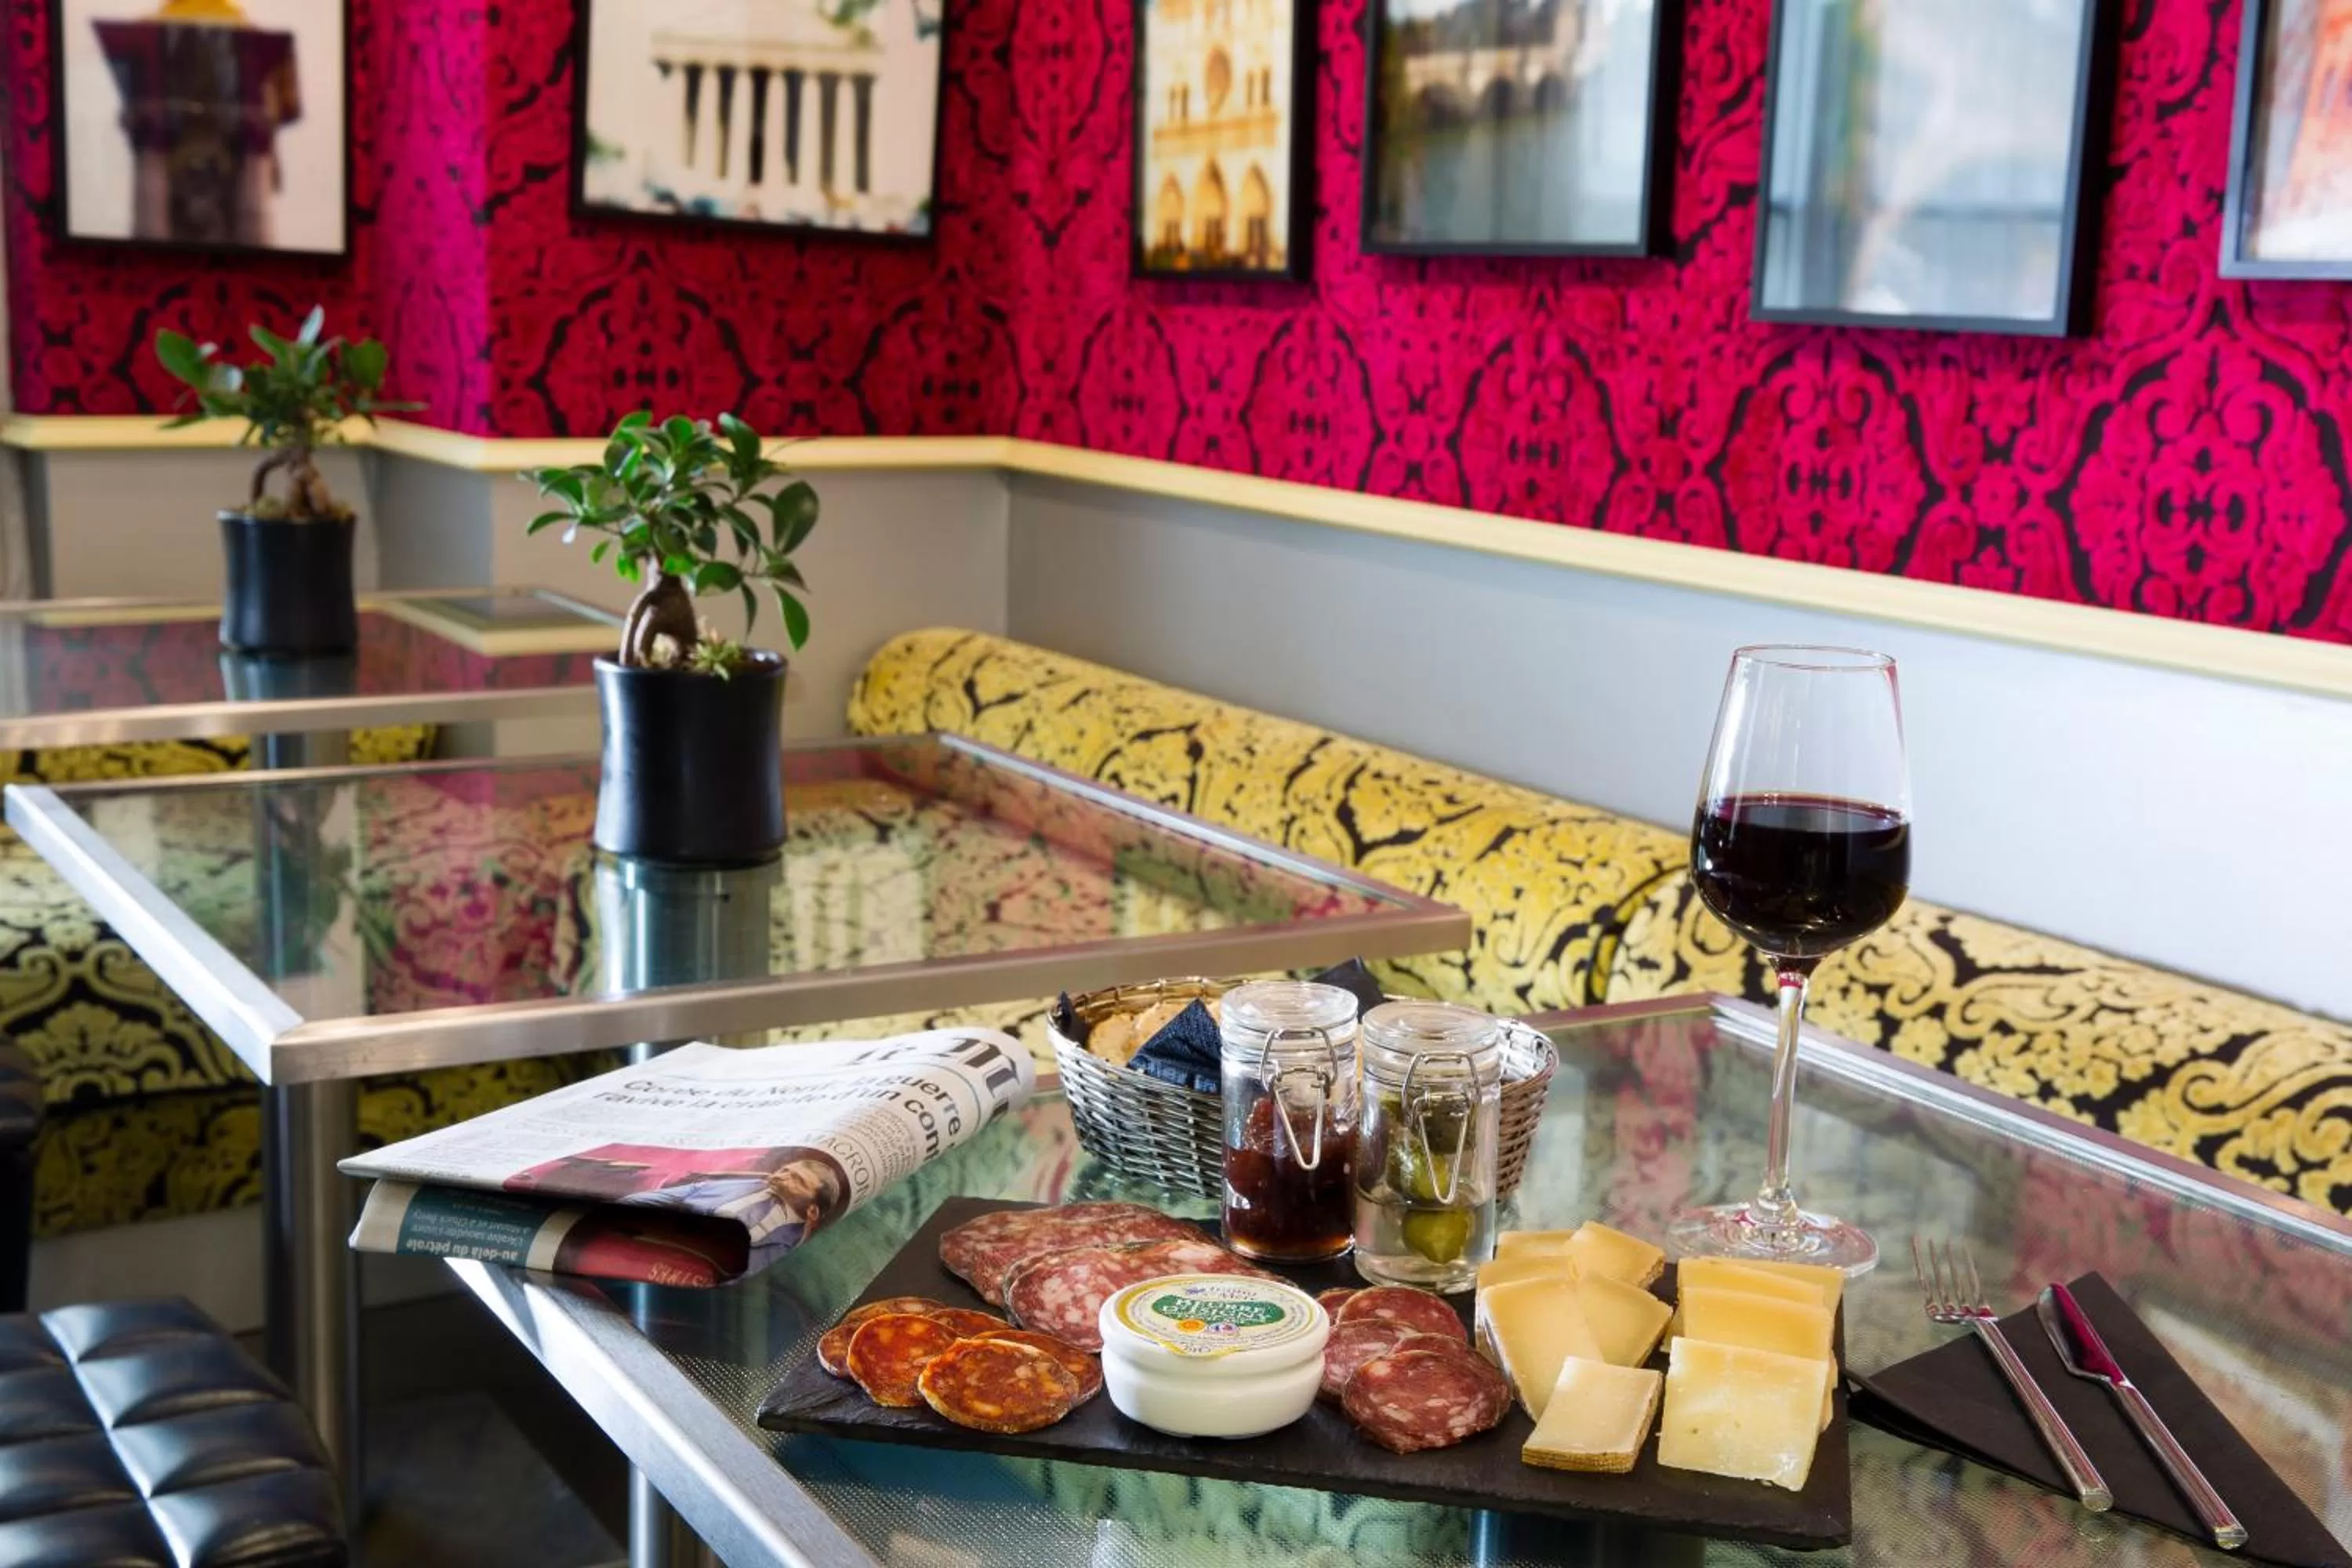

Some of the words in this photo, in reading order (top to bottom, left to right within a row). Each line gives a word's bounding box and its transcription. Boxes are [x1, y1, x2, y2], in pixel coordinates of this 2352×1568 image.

[877, 1075, 962, 1137] guerre
[405, 1237, 451, 1255] pétrole
[452, 1243, 469, 1255] du
[470, 1246, 518, 1261] au-delà
